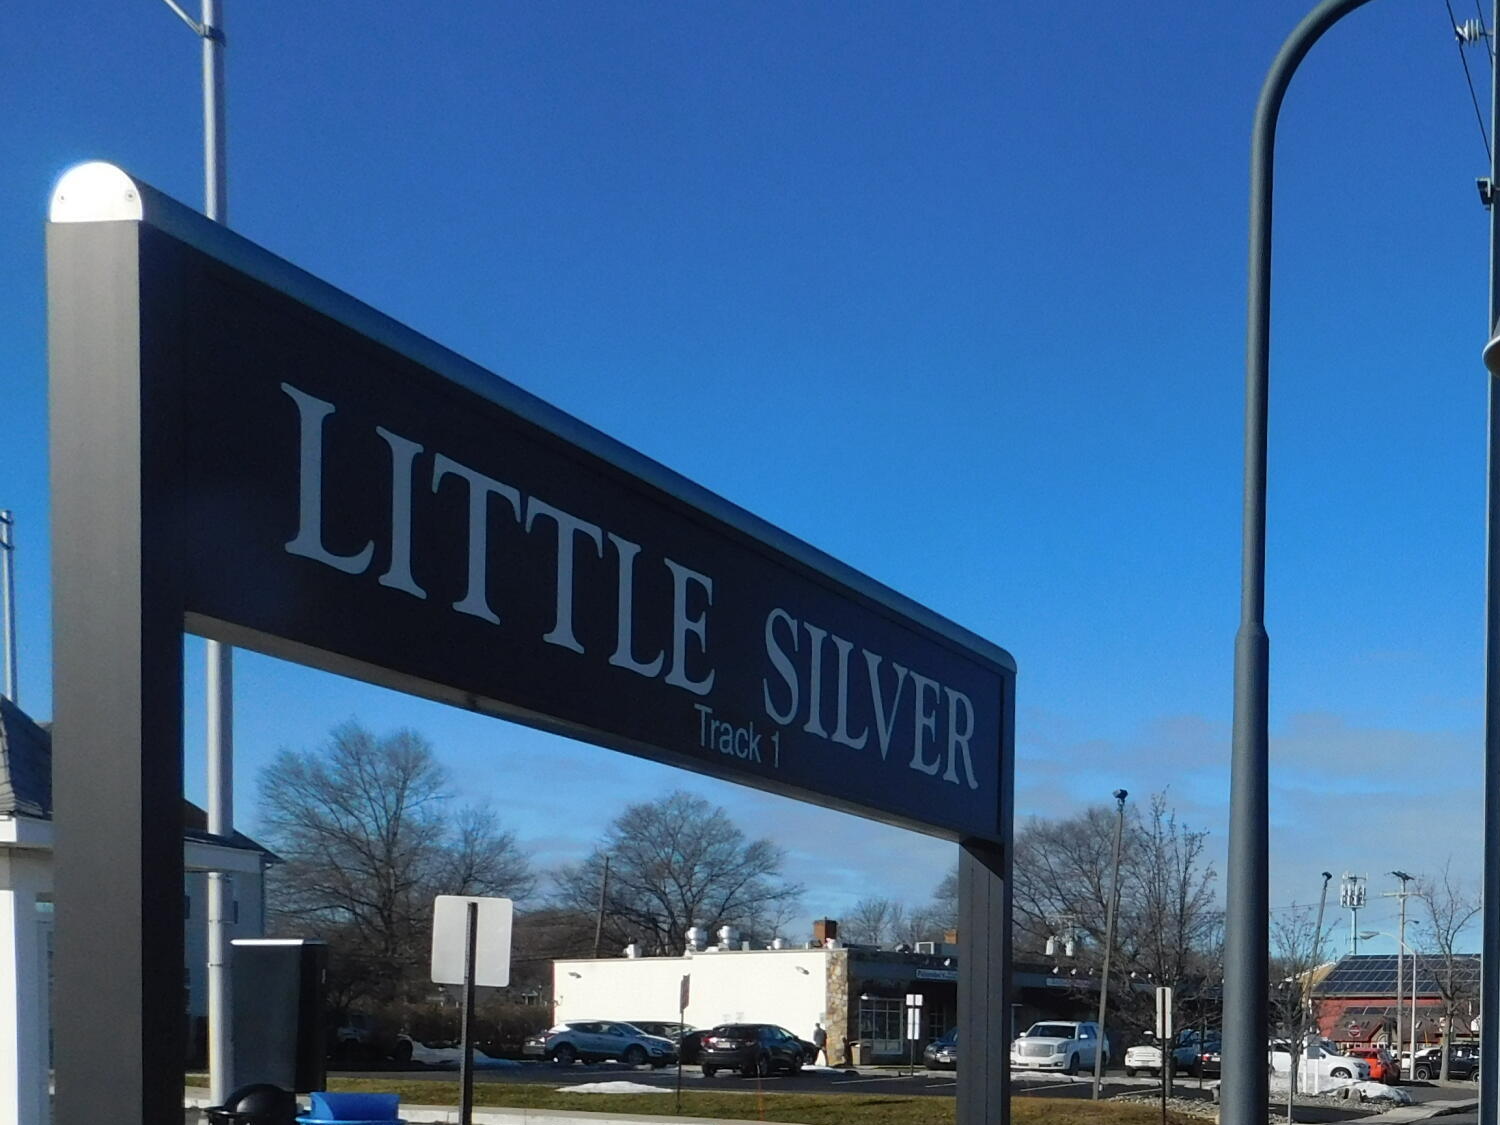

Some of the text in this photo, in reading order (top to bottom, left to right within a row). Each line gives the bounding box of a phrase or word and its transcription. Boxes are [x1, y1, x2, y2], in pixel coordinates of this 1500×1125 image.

[281, 382, 979, 790] LITTLE SILVER
[693, 703, 780, 769] Track 1
